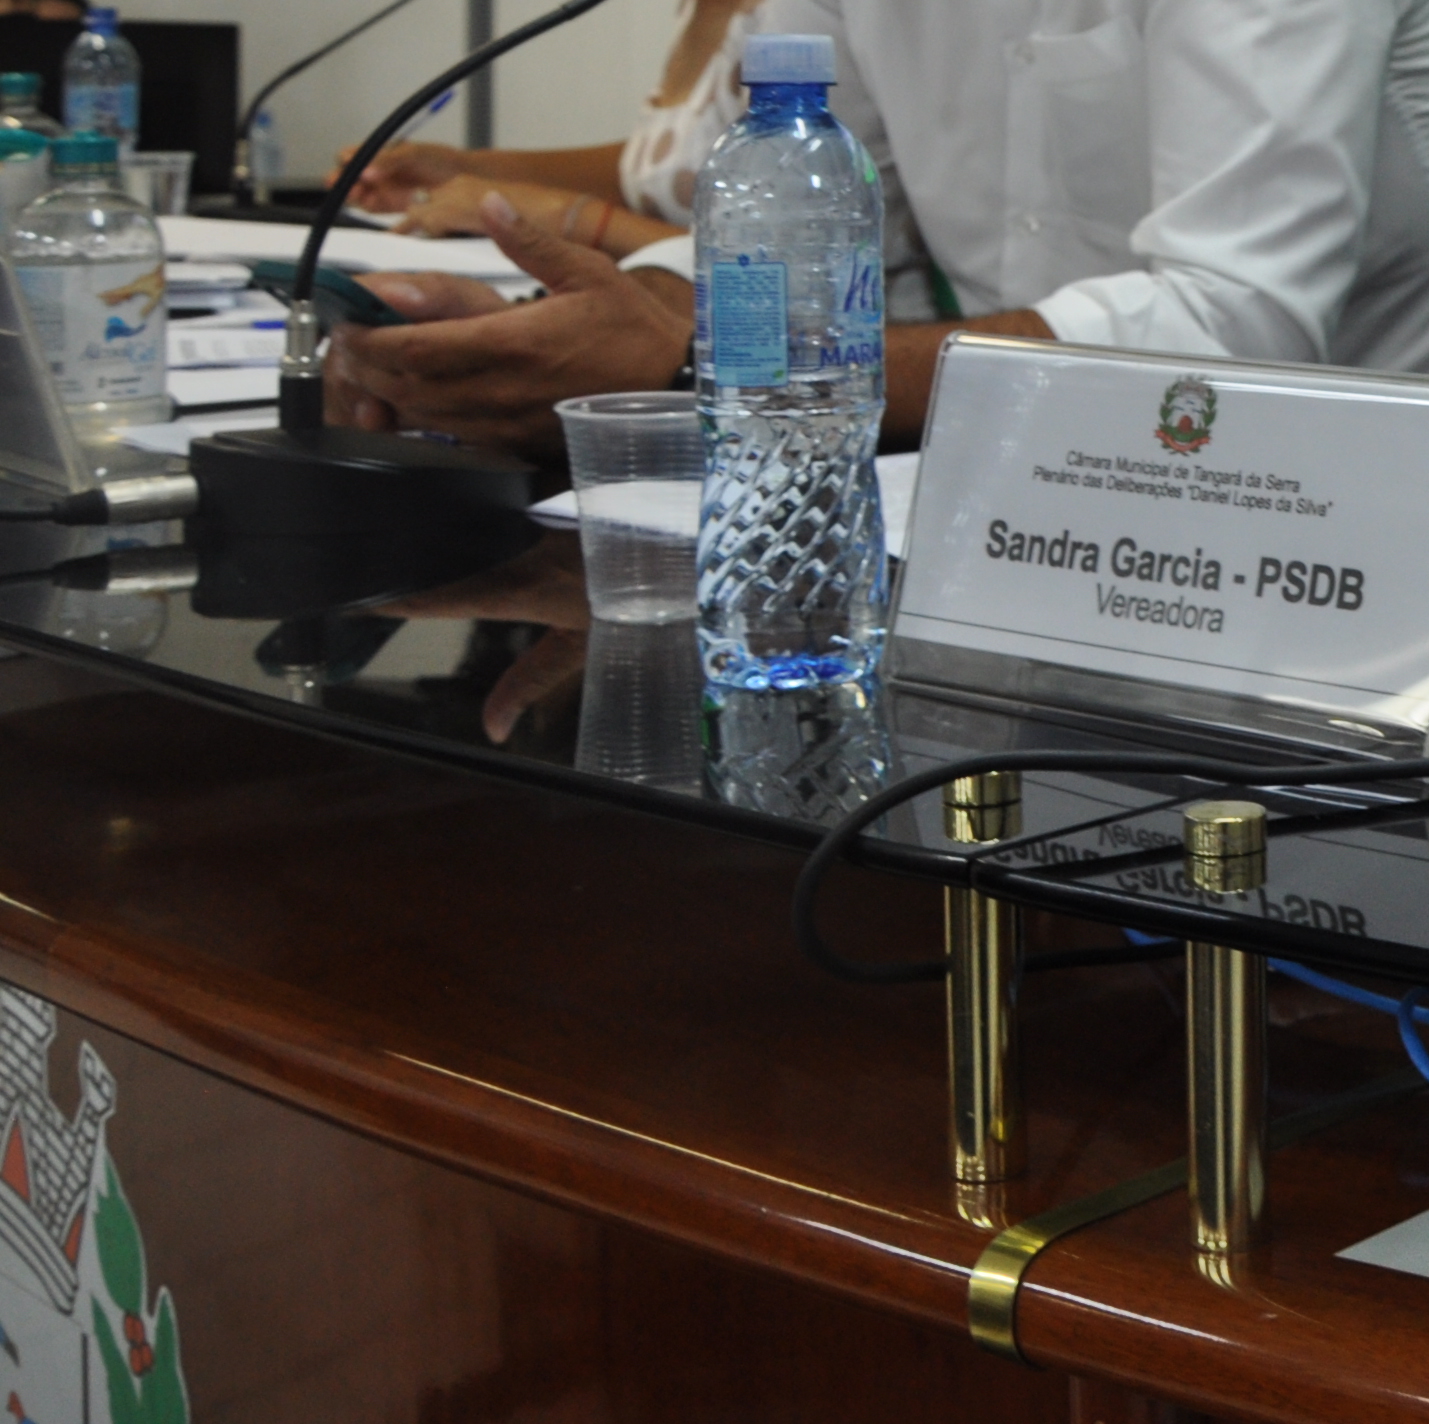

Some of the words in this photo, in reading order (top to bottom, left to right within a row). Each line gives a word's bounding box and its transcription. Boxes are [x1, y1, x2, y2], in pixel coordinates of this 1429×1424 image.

[1033, 465, 1079, 486] Plenário
[1082, 472, 1103, 489] das
[1106, 475, 1183, 500] Deliberações
[1233, 490, 1272, 512] Lopes
[1275, 497, 1292, 513] da
[1066, 449, 1113, 470] Câmara
[1115, 456, 1172, 479] Municipal
[1174, 462, 1190, 480] de
[1192, 465, 1242, 487] Tangará
[1245, 472, 1262, 488] da
[1264, 474, 1301, 493] Serra
[985, 520, 1100, 573] Sandra
[1110, 536, 1222, 592] Garcia
[1257, 557, 1365, 612] PSDB
[1096, 582, 1225, 634] Vereadora
